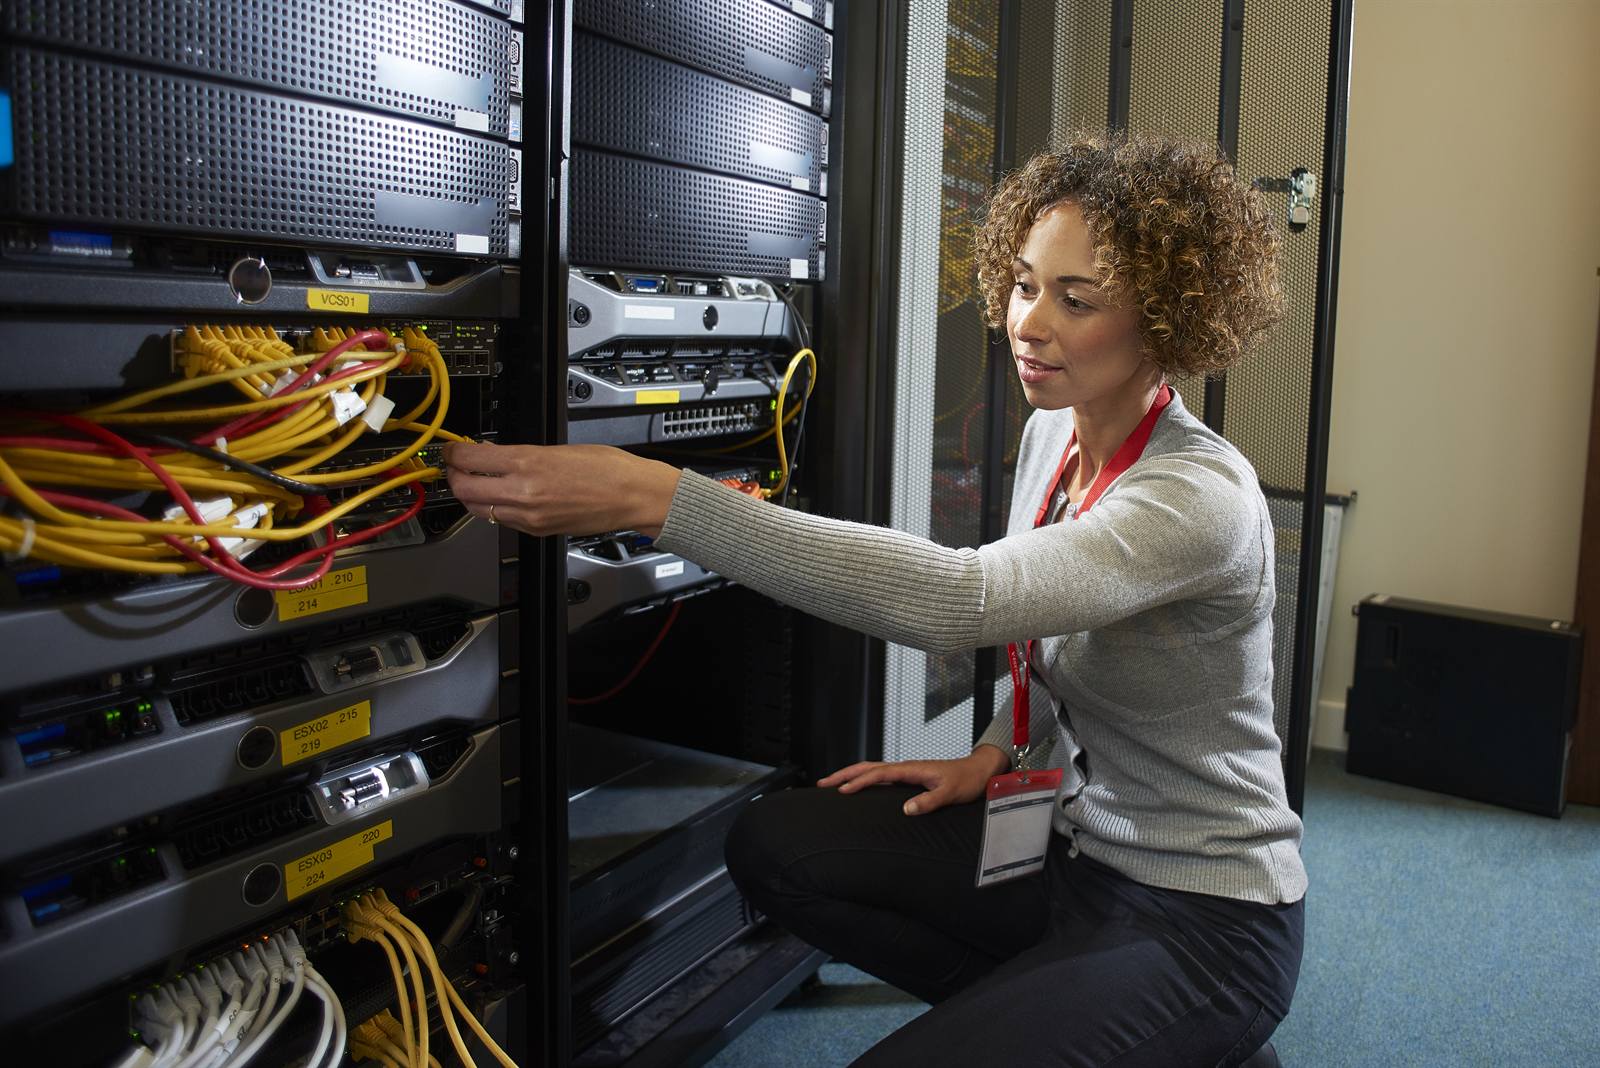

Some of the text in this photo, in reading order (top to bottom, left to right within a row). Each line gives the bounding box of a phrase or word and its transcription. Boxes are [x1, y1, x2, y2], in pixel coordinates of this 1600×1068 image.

[321, 293, 355, 307] VCS01
[294, 719, 328, 740] ESX02
[298, 849, 333, 872] ESX03
